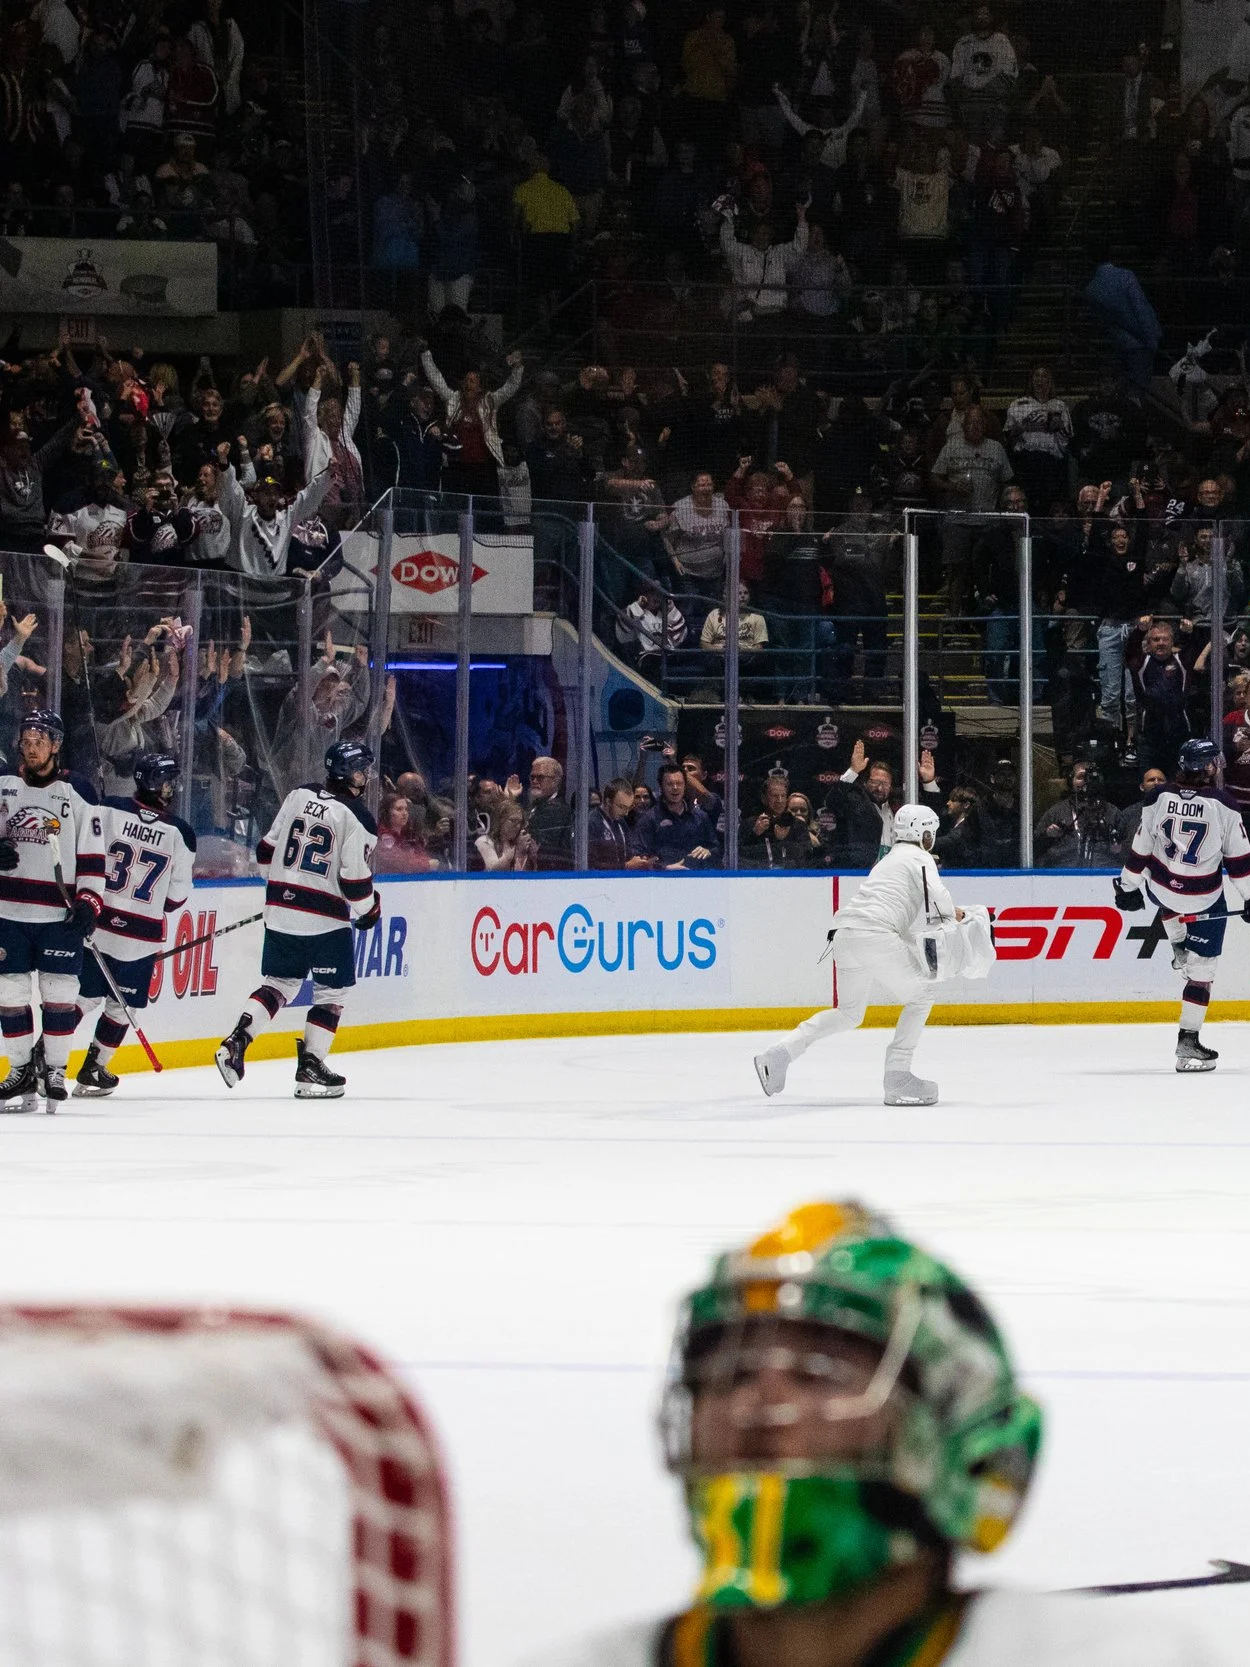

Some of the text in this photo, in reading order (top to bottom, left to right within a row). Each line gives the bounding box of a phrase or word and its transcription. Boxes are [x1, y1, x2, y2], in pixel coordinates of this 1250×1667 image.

[409, 621, 434, 643] EXIT
[61, 802, 70, 818] C
[303, 800, 329, 820] BECK
[1168, 801, 1204, 818] BLOOM
[122, 821, 165, 846] HAIGHT
[1160, 816, 1209, 867] 17
[283, 816, 336, 879] 62
[105, 839, 171, 904] 37
[471, 903, 718, 977] CarGurus
[43, 949, 76, 958] CCM
[172, 909, 218, 1000] OIL
[312, 966, 337, 975] CCM
